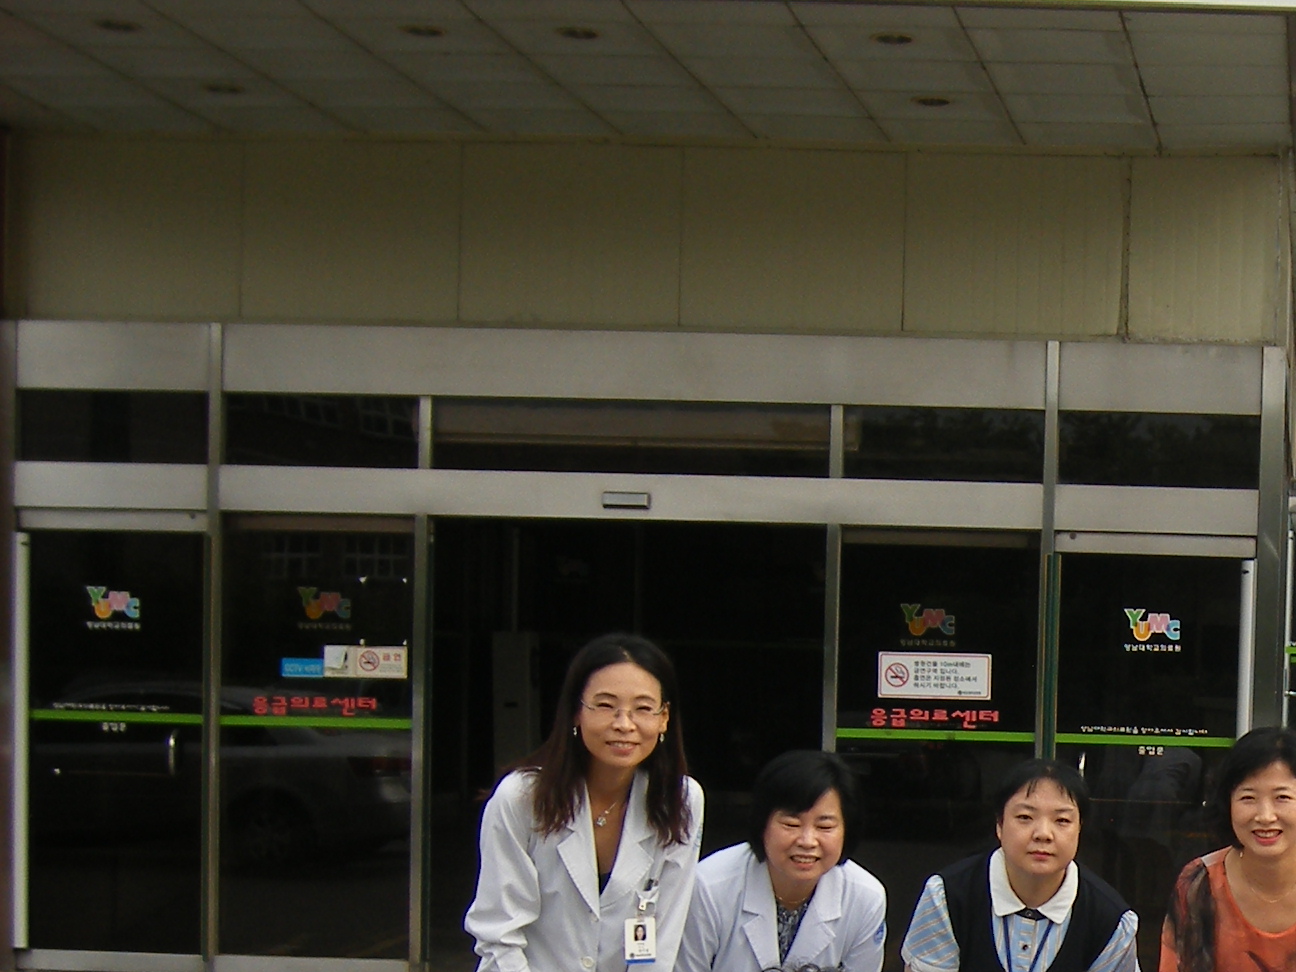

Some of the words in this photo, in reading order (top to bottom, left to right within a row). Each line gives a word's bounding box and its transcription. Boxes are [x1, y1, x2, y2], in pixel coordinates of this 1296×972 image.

[86, 586, 140, 619] YUMC
[900, 603, 955, 636] YUMC
[1124, 608, 1181, 642] YUMC
[871, 708, 999, 729] 응급의료센터
